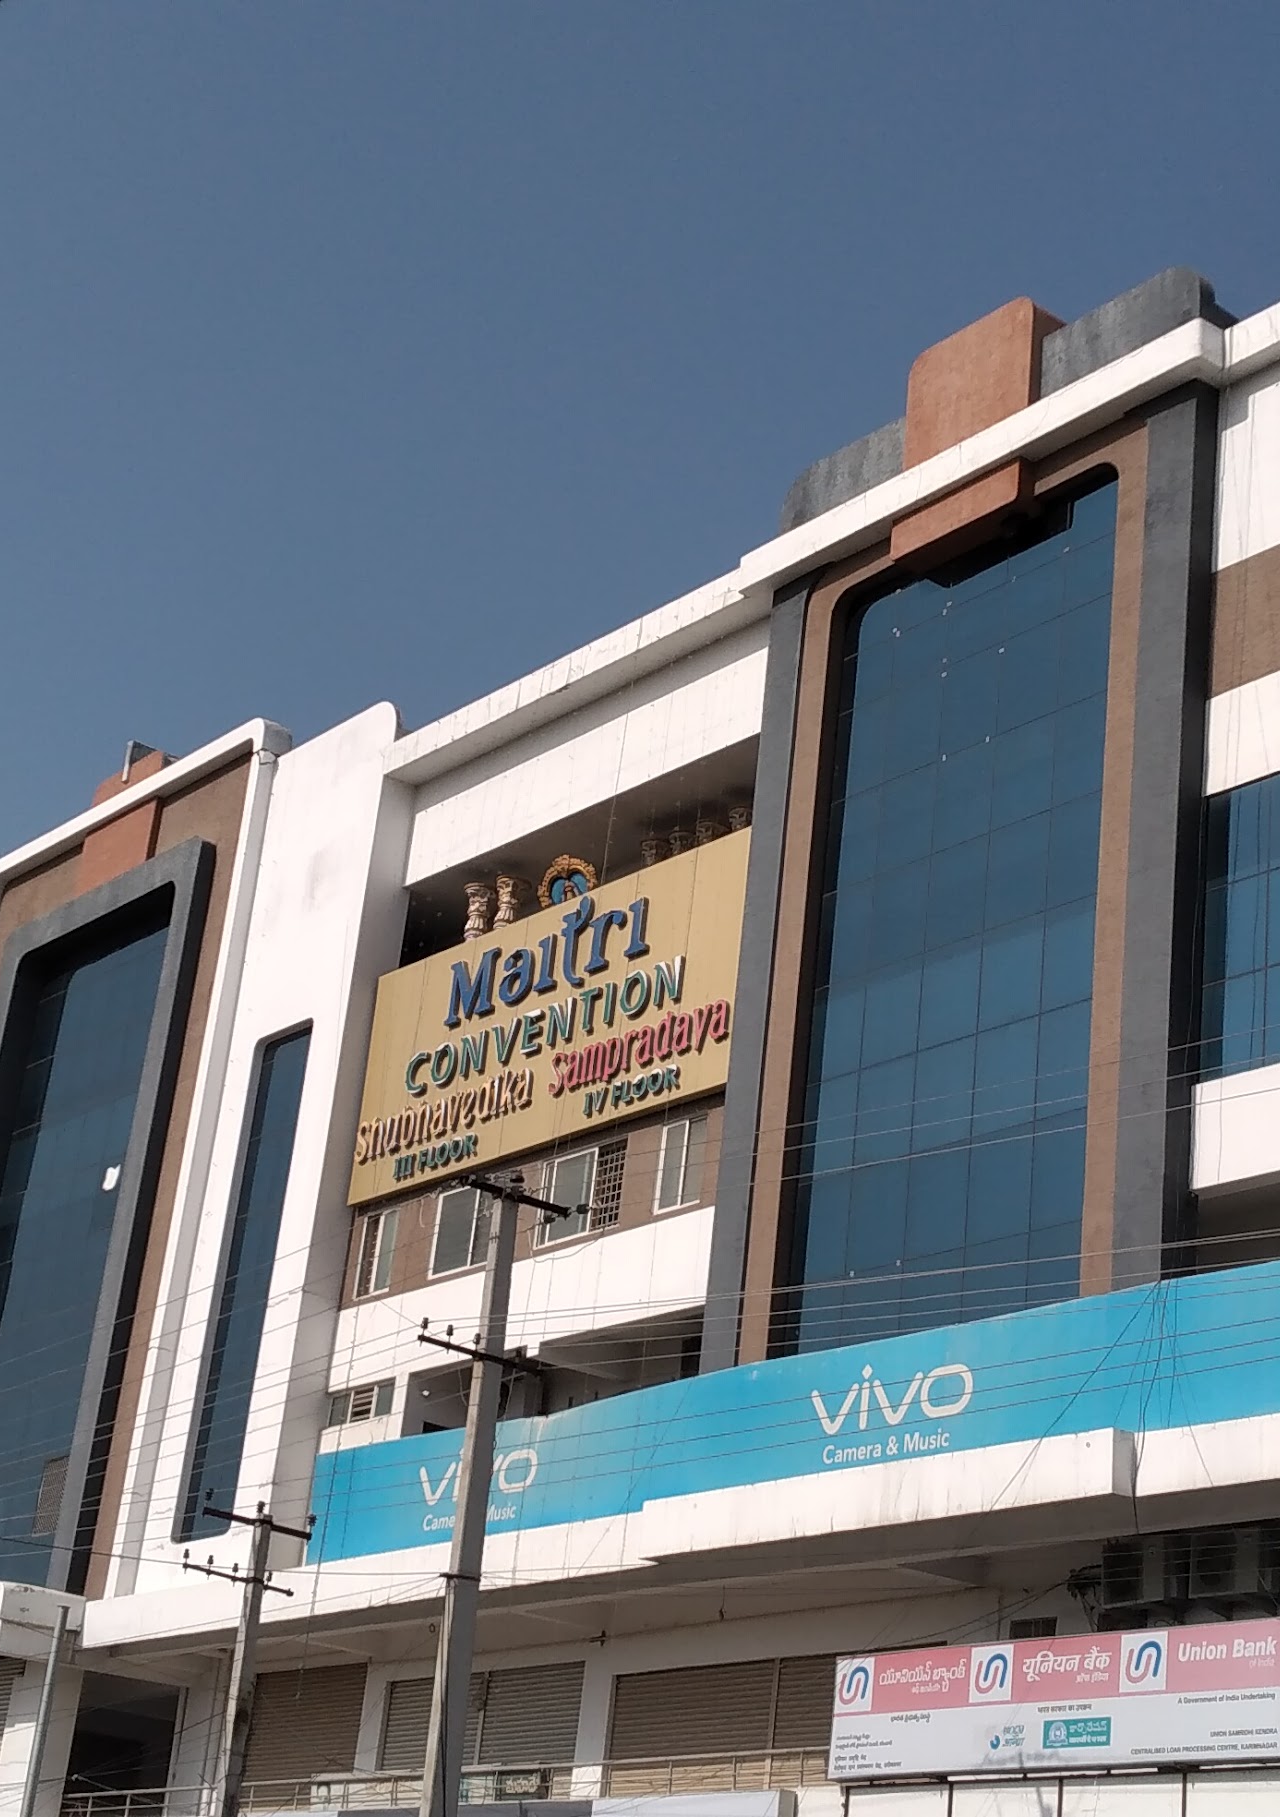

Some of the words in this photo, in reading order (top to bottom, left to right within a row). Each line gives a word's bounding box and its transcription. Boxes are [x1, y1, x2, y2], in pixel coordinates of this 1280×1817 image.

[444, 895, 650, 1027] Maitri
[405, 955, 685, 1096] CONVENTION
[548, 998, 730, 1096] Sampradaya
[583, 1084, 604, 1117] IV
[611, 1064, 681, 1109] FLOOR
[393, 1152, 414, 1181] III
[418, 1132, 479, 1174] FLOOR
[811, 1364, 974, 1435] vivo
[822, 1441, 882, 1465] Camera
[886, 1435, 899, 1456] &
[903, 1428, 950, 1453] Music
[420, 1448, 538, 1506] vio
[1022, 1650, 1081, 1682] यूनियन
[1084, 1645, 1112, 1671] बैंक
[1178, 1641, 1226, 1662] Union
[1232, 1636, 1277, 1658] Bank
